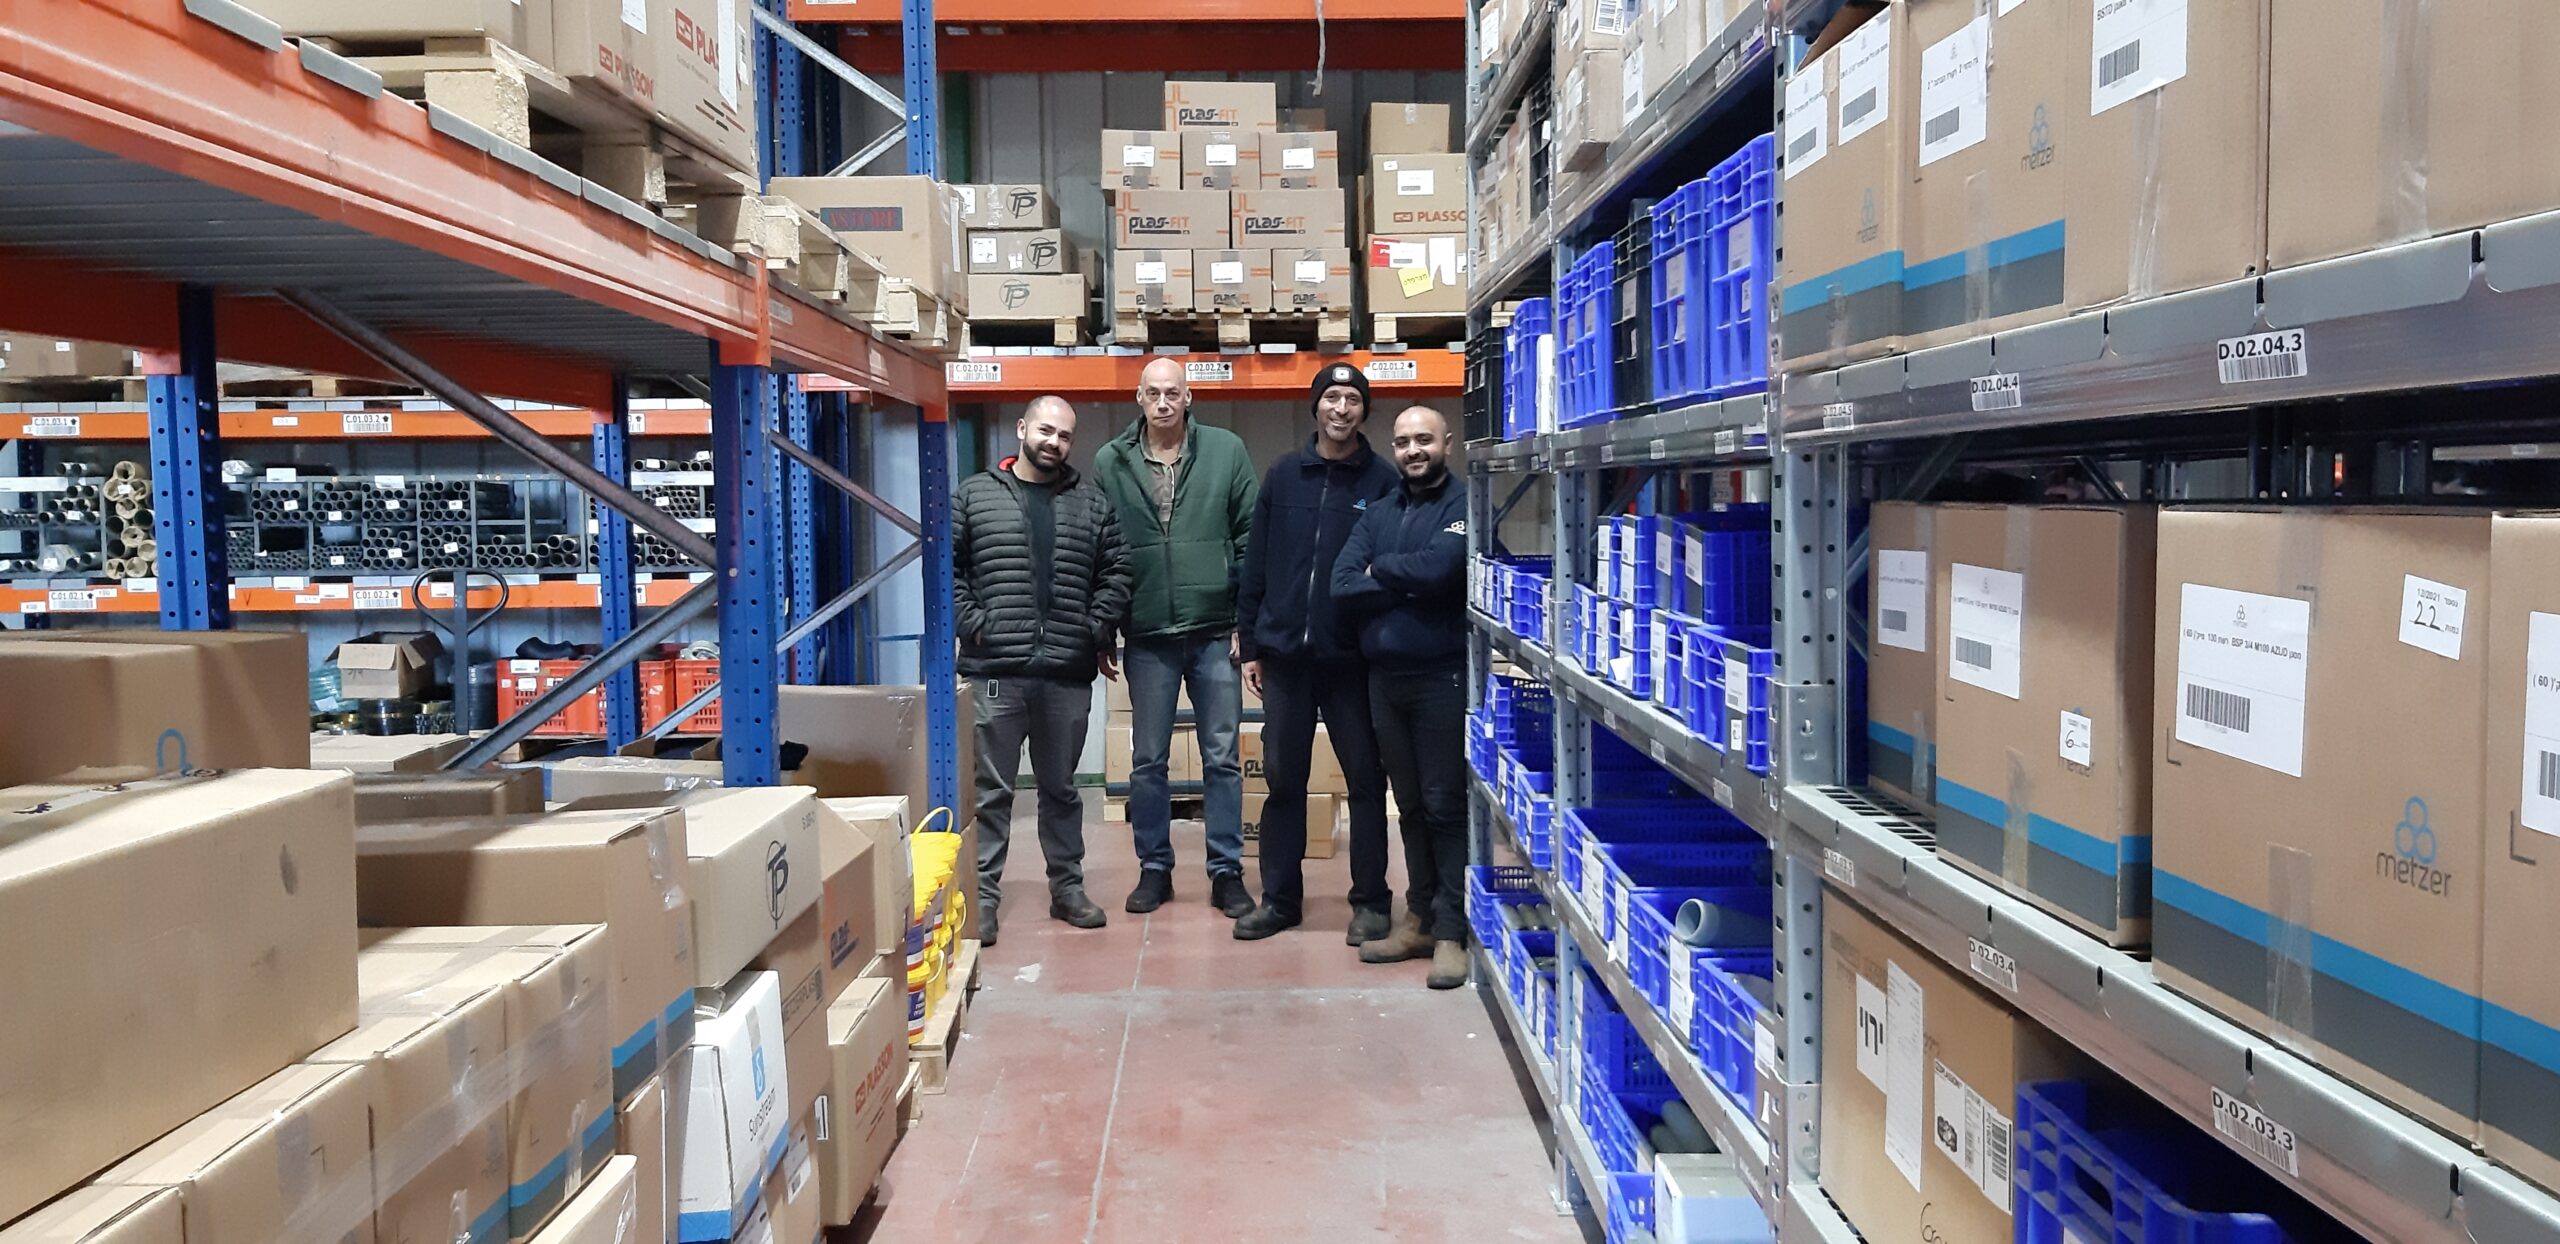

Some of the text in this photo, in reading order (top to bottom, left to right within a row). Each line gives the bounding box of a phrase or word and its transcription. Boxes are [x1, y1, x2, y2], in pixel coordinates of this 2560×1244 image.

[1011, 192, 1037, 219] TP
[1417, 211, 1466, 223] PLASSO
[1030, 241, 1058, 269] TP
[1004, 283, 1030, 311] TP
[2219, 333, 2302, 360] D.02.04.3
[955, 364, 989, 372] C.02.02.1
[1187, 362, 1221, 372] C.02.02.2
[1371, 362, 1405, 371] C.02.01.2
[1971, 375, 2019, 394] D.02.04.4
[34, 418, 68, 426] C.01.03.1
[345, 415, 380, 423] C.01.03.2
[50, 592, 84, 600] C.01.02.1
[355, 590, 389, 599] C.01.02.2
[2417, 588, 2440, 602] 12/2021
[2414, 600, 2440, 631] 22
[2231, 637, 2244, 648] BSP
[2376, 852, 2452, 897] metzer
[767, 843, 789, 930] TP
[1969, 939, 2015, 975] D.02.03.4
[2212, 1090, 2293, 1151] D.02.03.3
